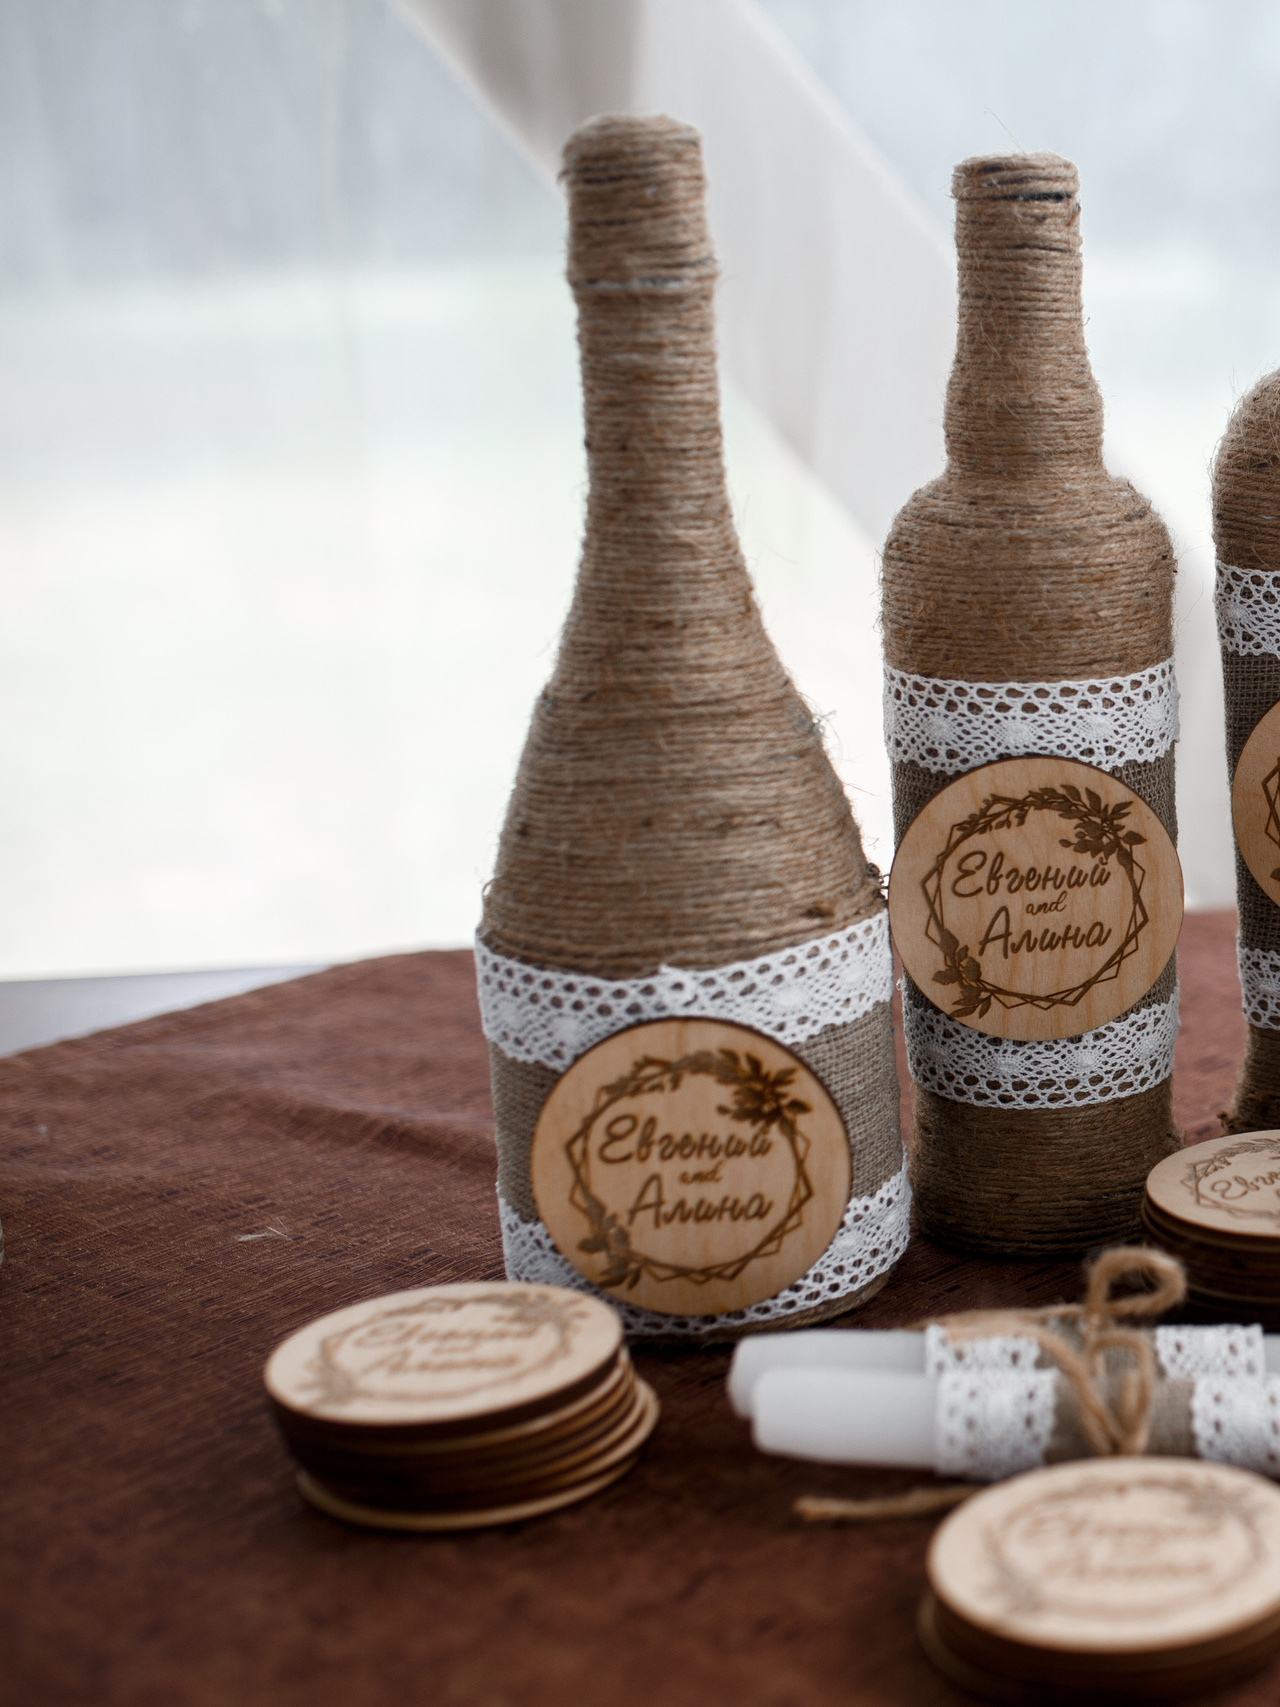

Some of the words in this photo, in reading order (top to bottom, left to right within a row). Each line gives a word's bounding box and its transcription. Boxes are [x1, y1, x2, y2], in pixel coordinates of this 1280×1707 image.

[952, 850, 1111, 898] Евгений
[1025, 890, 1068, 916] and
[978, 905, 1112, 959] Алина
[598, 1113, 775, 1165] Евгений
[627, 1173, 775, 1229] Алина
